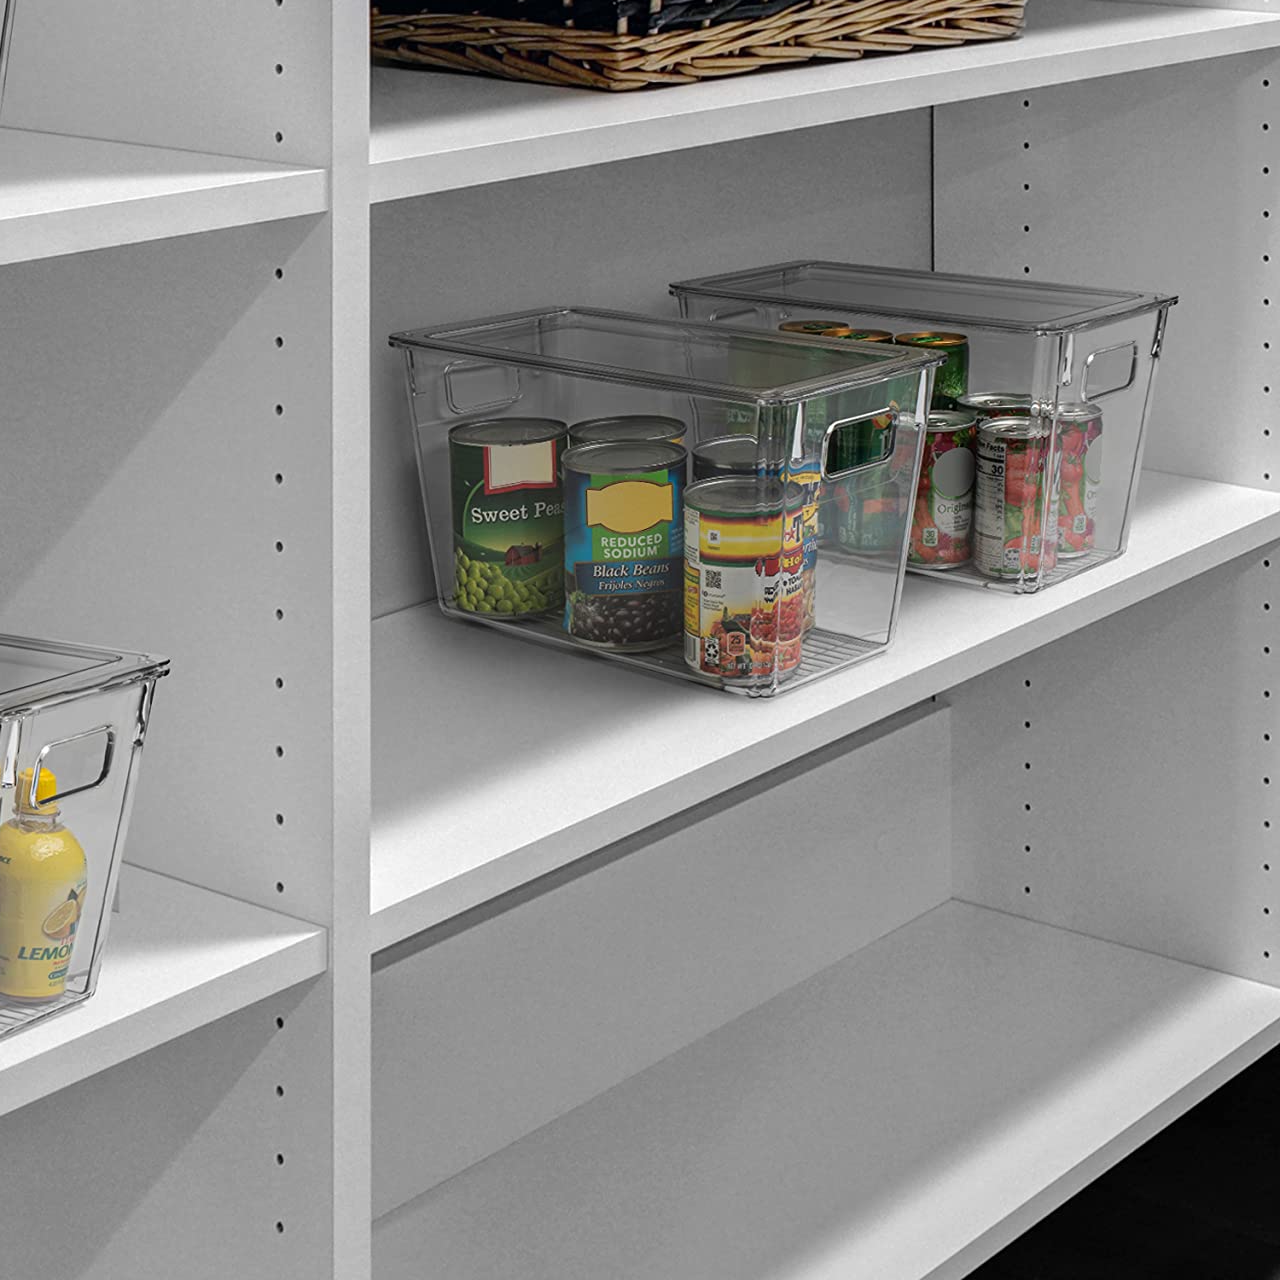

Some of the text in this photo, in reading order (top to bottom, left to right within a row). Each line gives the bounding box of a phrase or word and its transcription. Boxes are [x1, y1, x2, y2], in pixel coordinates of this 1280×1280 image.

[986, 440, 1005, 452] Facts
[991, 464, 1004, 476] 30
[471, 504, 529, 524] Sweet
[600, 533, 663, 548] REDUCED
[603, 547, 658, 559] SODIUM
[593, 562, 670, 578] Black Beans
[598, 579, 665, 591] Frijoles Negros
[730, 635, 741, 645] 25
